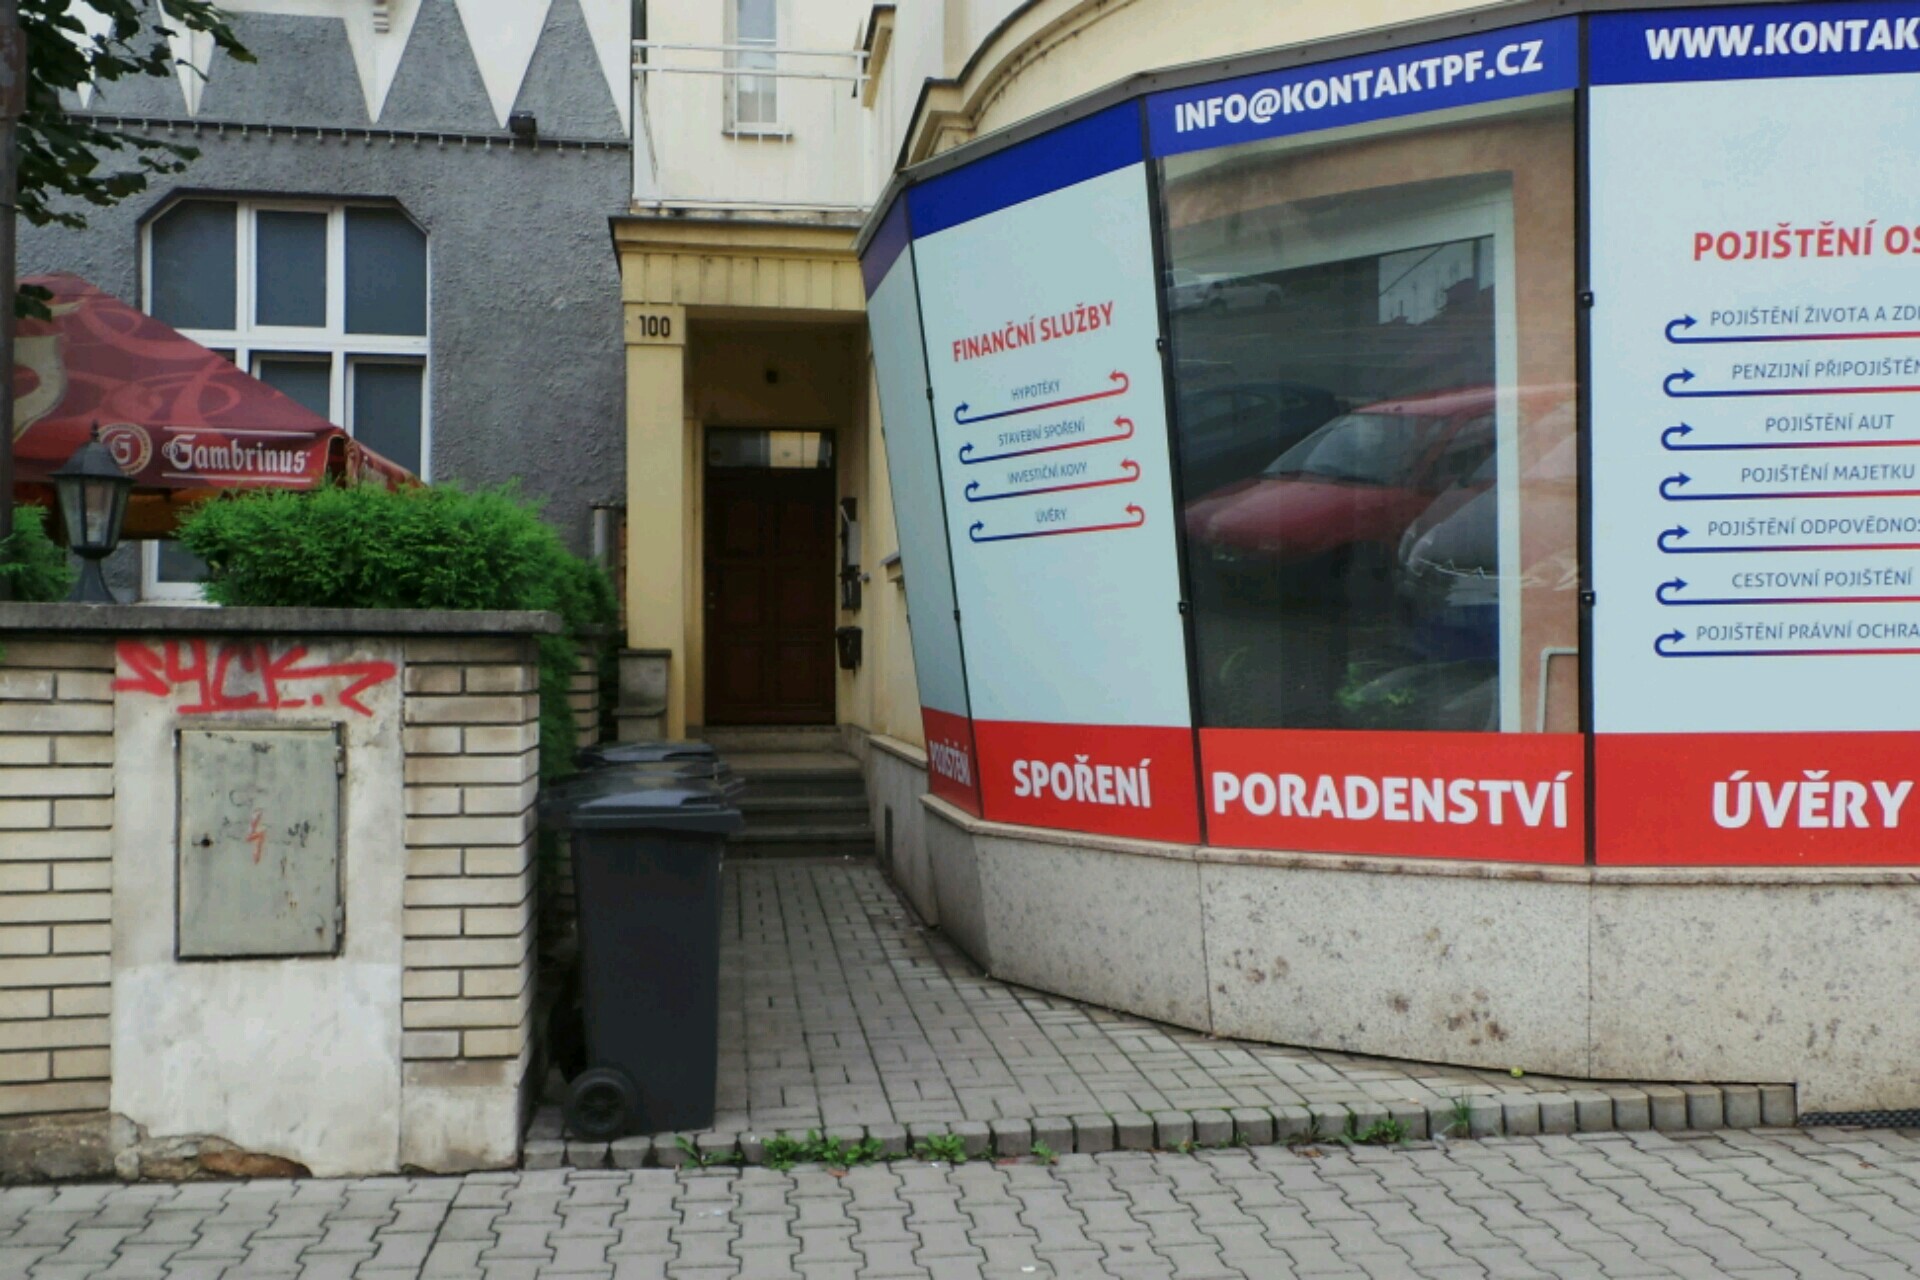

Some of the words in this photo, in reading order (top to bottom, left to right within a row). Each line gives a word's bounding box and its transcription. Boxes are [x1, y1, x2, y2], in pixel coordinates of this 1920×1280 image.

[1174, 39, 1544, 133] INFO@KONTAKTPF.CZ
[1693, 219, 1879, 261] POJIŠTĚNÍ
[638, 315, 671, 337] 100
[1710, 306, 1799, 326] POJIŠTĚNÍ
[1804, 305, 1870, 324] ŽIVOTA
[1874, 305, 1887, 322] A
[1892, 305, 1920, 322] ZD
[952, 314, 1036, 362] FINANČNÍ
[1040, 300, 1114, 342] SLUŽBY
[1731, 359, 1811, 380] PENZIJNÍ
[1011, 380, 1061, 400] HYPOTÉKY
[997, 424, 1041, 447] STAVEBNÍ
[1044, 416, 1086, 440] SPOŘENÍ
[1765, 413, 1854, 432] POJIŠTĚNÍ
[1858, 414, 1895, 430] AUT
[163, 434, 306, 473] Gambrinus
[1007, 463, 1058, 484] INVESTIČNÍ
[1060, 461, 1087, 477] KOVY
[1741, 463, 1829, 483] POJIŠTĚNÍ
[1833, 464, 1915, 481] MAJETKU
[1035, 506, 1067, 524] ÚVĚRY
[1707, 517, 1796, 537] POJIŠTĚNÍ
[1801, 515, 1920, 535] ODPOVĚDNO
[1731, 568, 1820, 588] CESTOVNÍ
[1824, 567, 1914, 587] POJIŠTĚNÍ
[1696, 622, 1784, 641] POJIŠTĚNÍ
[1788, 620, 1853, 640] PRÁVNÍ
[1012, 754, 1152, 808] SPOŘENÍ
[1212, 771, 1573, 828] PORADENSTVÍ
[1712, 769, 1915, 828] ÚVĚRY
